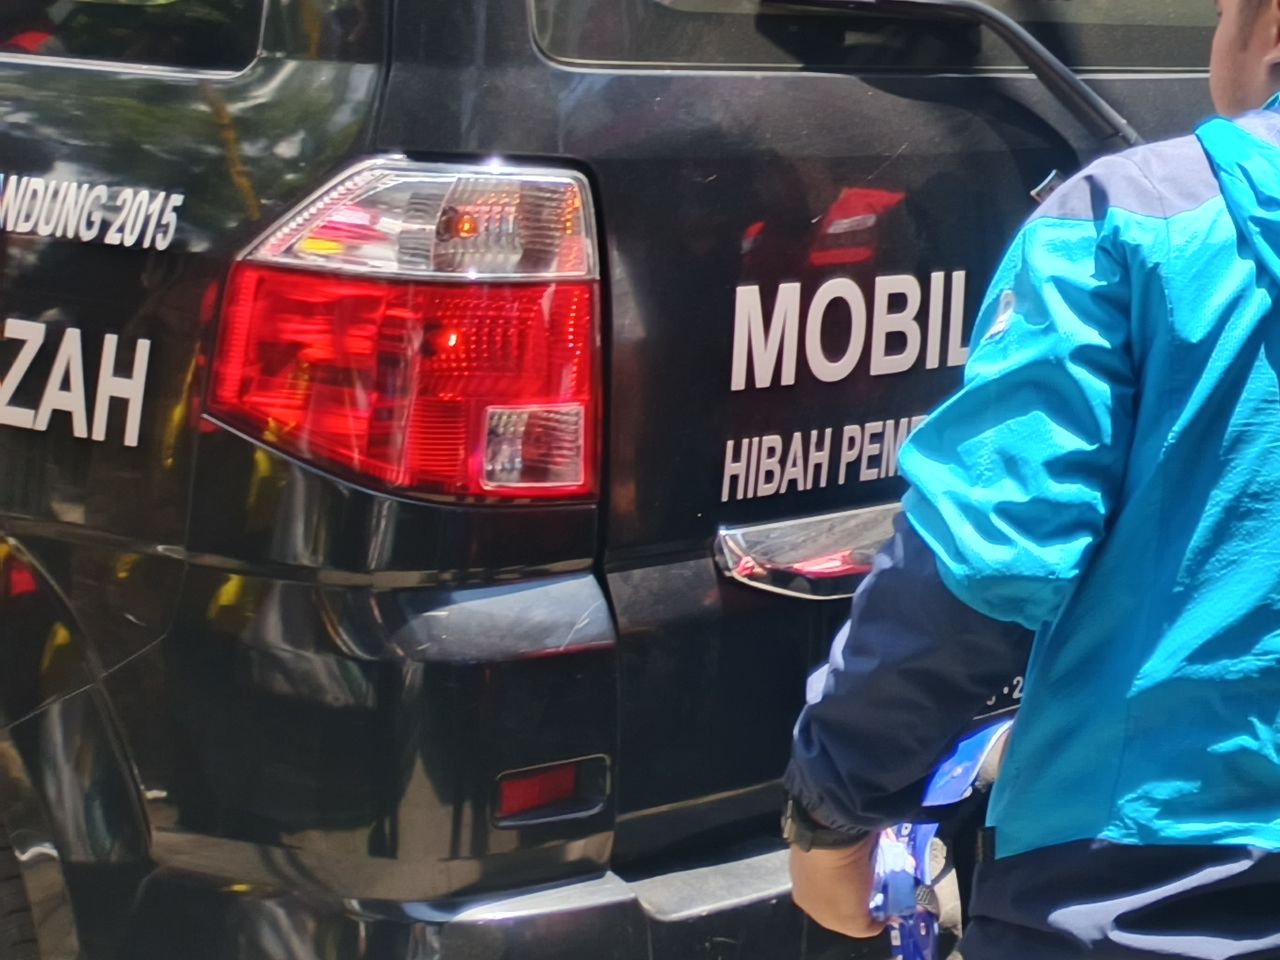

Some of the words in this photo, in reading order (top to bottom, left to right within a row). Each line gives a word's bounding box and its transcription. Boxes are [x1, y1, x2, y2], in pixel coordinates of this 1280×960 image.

[104, 188, 185, 252] 2015
[730, 270, 971, 392] MOBIL
[721, 427, 833, 503] HIBAH
[838, 415, 929, 486] PEM
